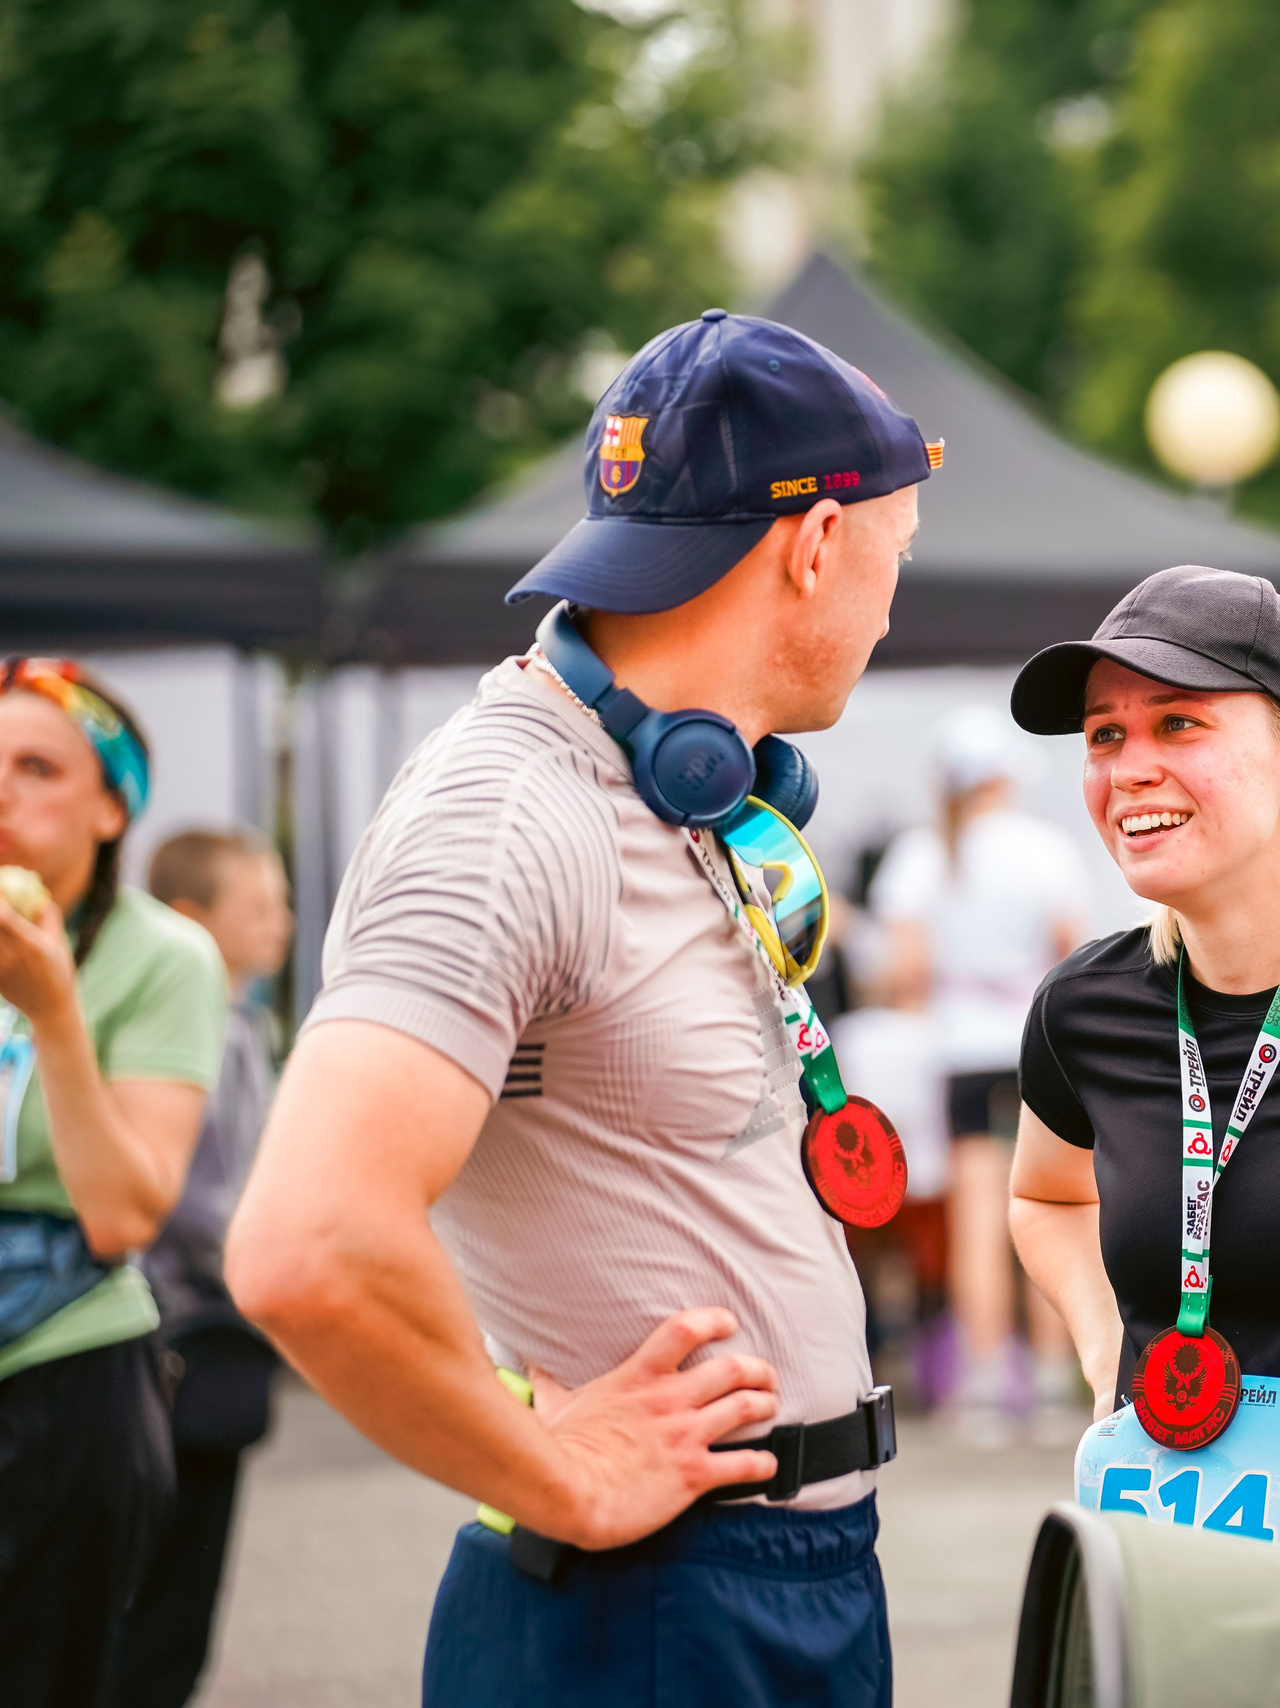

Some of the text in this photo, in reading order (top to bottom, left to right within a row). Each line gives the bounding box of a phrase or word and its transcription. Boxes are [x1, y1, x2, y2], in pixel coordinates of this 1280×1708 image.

[770, 471, 861, 499] SINCE 1899
[1240, 1384, 1277, 1404] РЕЙЛ
[1134, 1395, 1225, 1445] ЗАБЕГ МАГАС
[1099, 1465, 1276, 1543] 514
